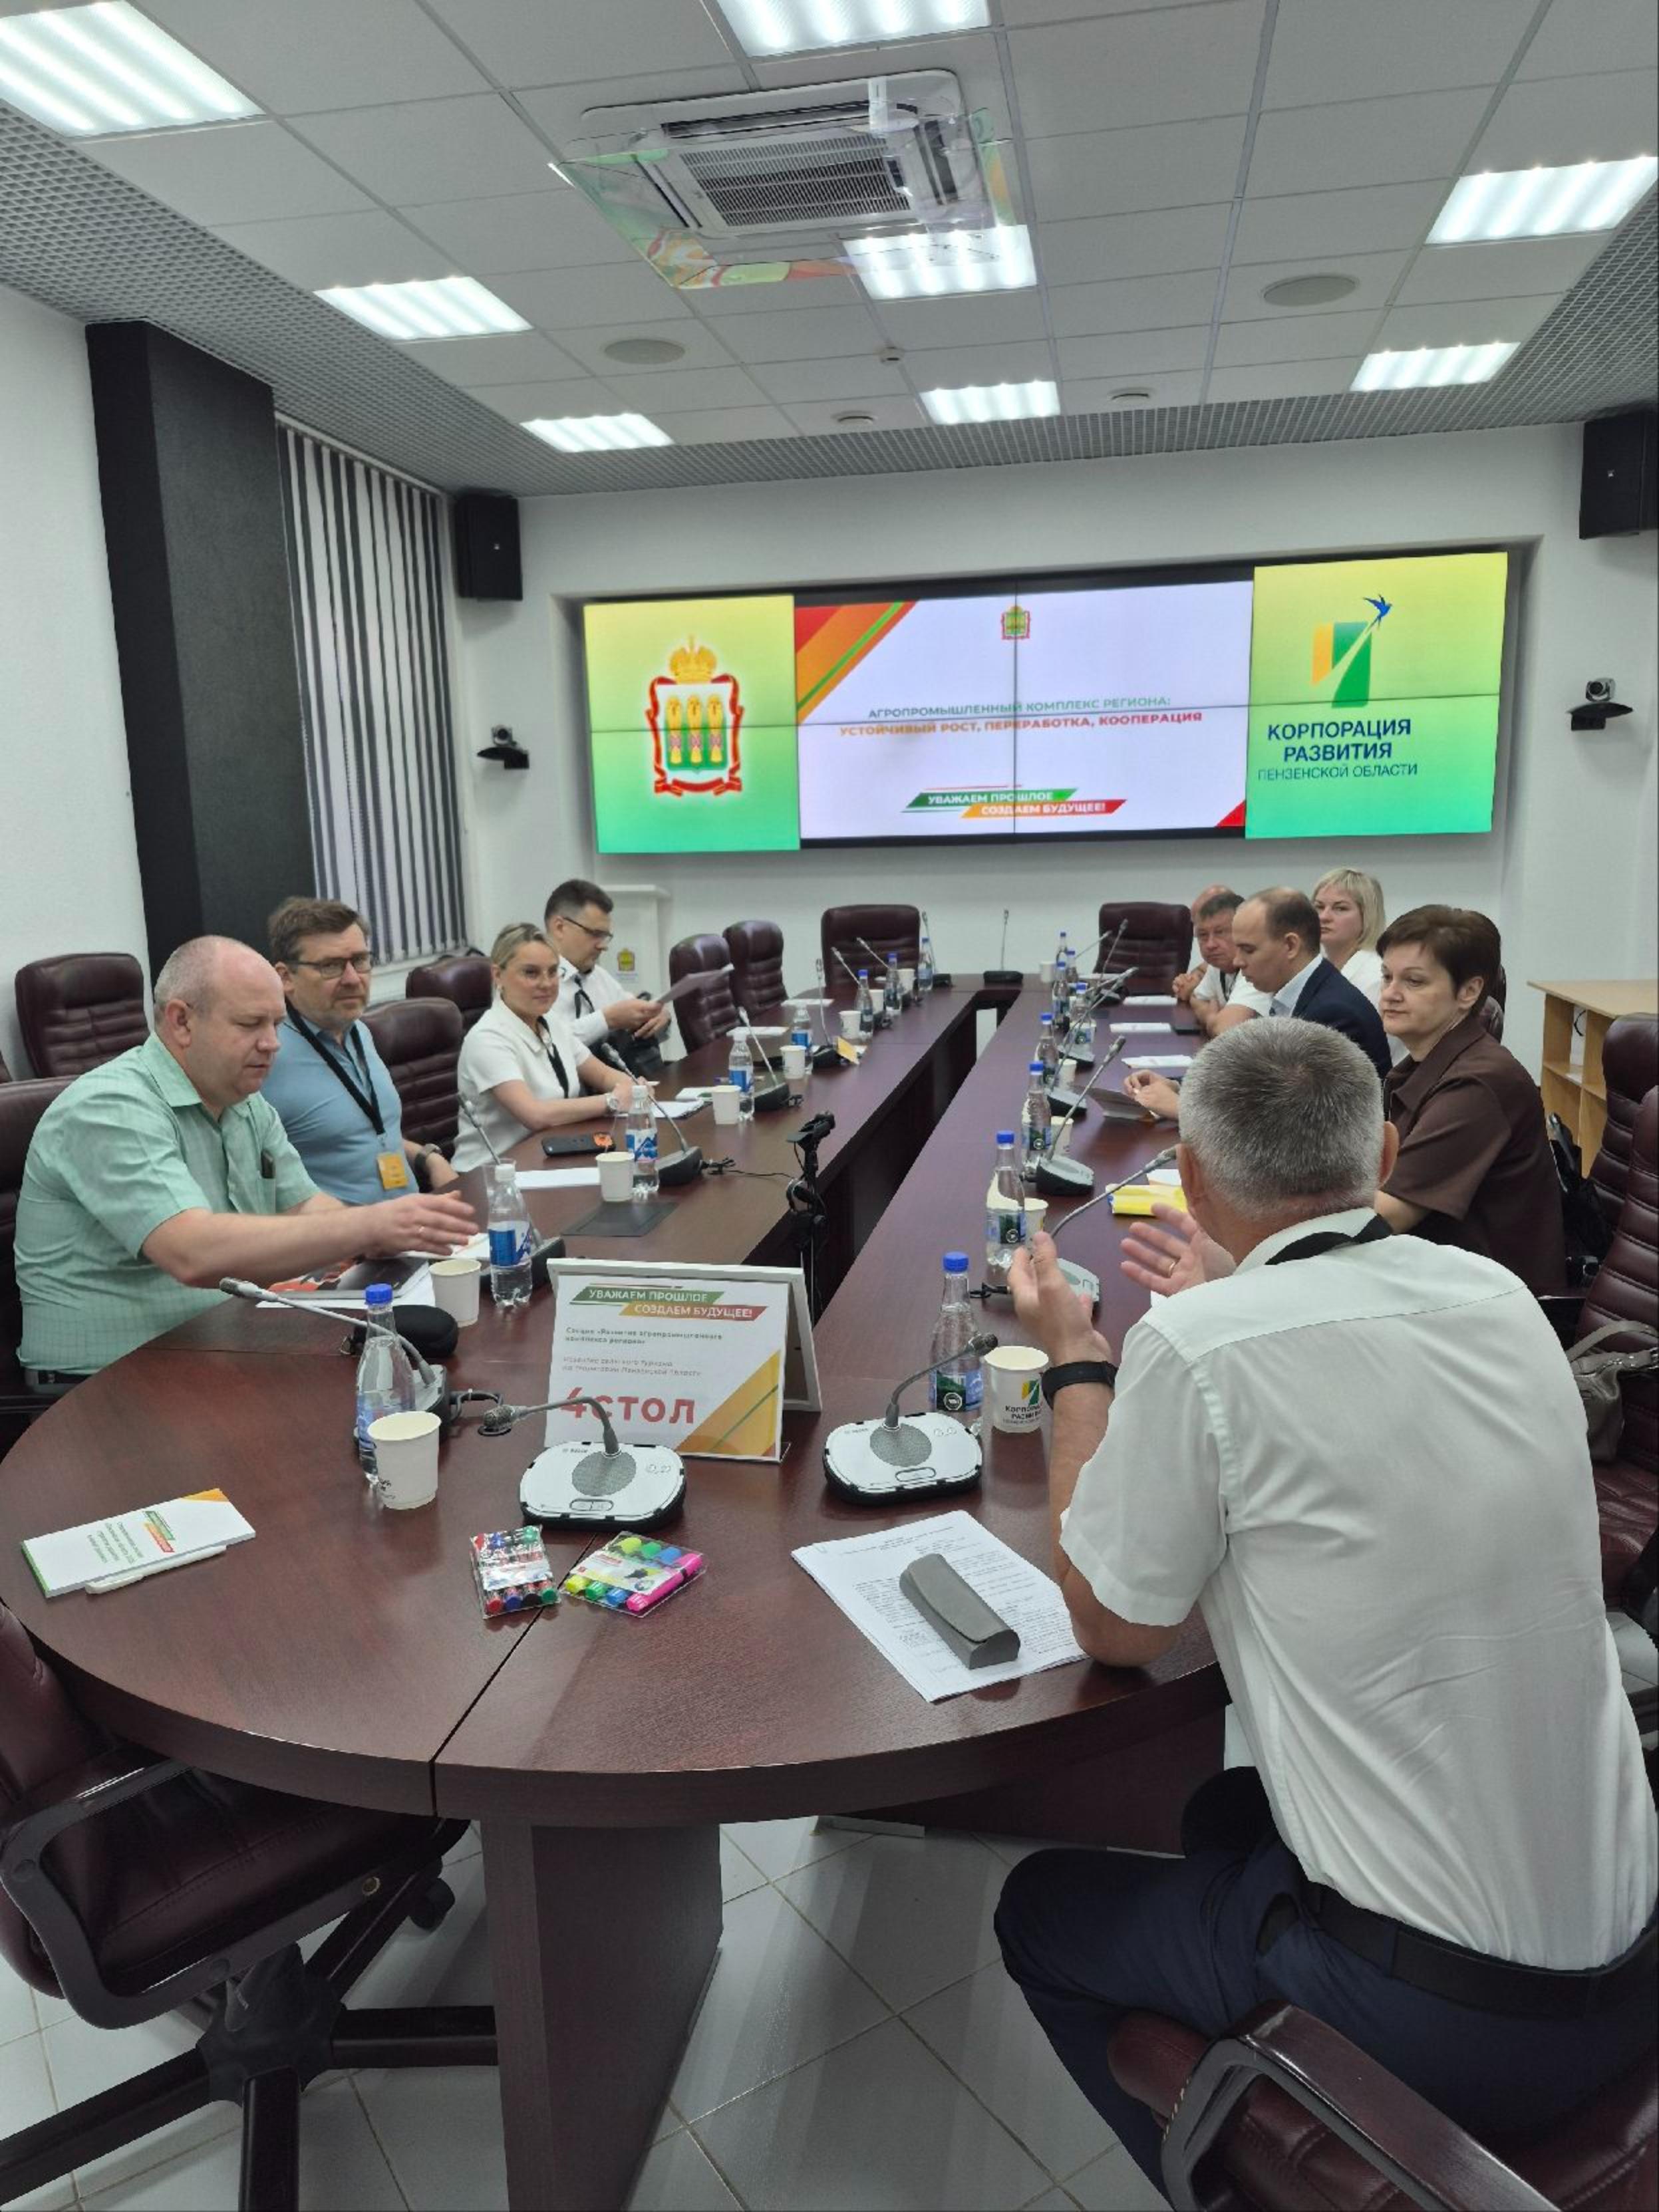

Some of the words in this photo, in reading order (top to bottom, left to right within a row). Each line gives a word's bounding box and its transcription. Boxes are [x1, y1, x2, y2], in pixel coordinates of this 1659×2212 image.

[868, 702, 1022, 719] АГРОПРОМЫШЛЕННЫЙ
[1026, 699, 1098, 712] КОМПЛЕКС
[1103, 696, 1171, 709] РЕГИОНА:
[840, 722, 936, 737] УСТОЙЧИВЫЙ
[940, 722, 980, 733] РОСТ,
[984, 716, 1095, 731] ПЕРЕРАБОТКА,
[1099, 712, 1202, 726] КООПЕРАЦИЯ
[1267, 718, 1412, 740] КОРПОРАЦИЯ
[1284, 742, 1392, 762] РАЗВИТИЯ
[1258, 765, 1348, 781] ПЕНЗЕНСКОЙ
[1352, 763, 1418, 777] ОБЛАСТИ
[927, 793, 988, 805] УВАЖАЕМ
[990, 791, 1054, 803] ПРОШЛОЕ
[980, 804, 1041, 815] СОЗДАЕМ
[1042, 802, 1106, 815] БУДУЩЕЕ!
[589, 1290, 647, 1301] УВАЖАЕМ
[649, 1292, 708, 1303] ПРОШЛОЕ
[634, 1304, 691, 1317] СОЗДАЕМ
[693, 1306, 753, 1319] БУДУЩЕЕ!
